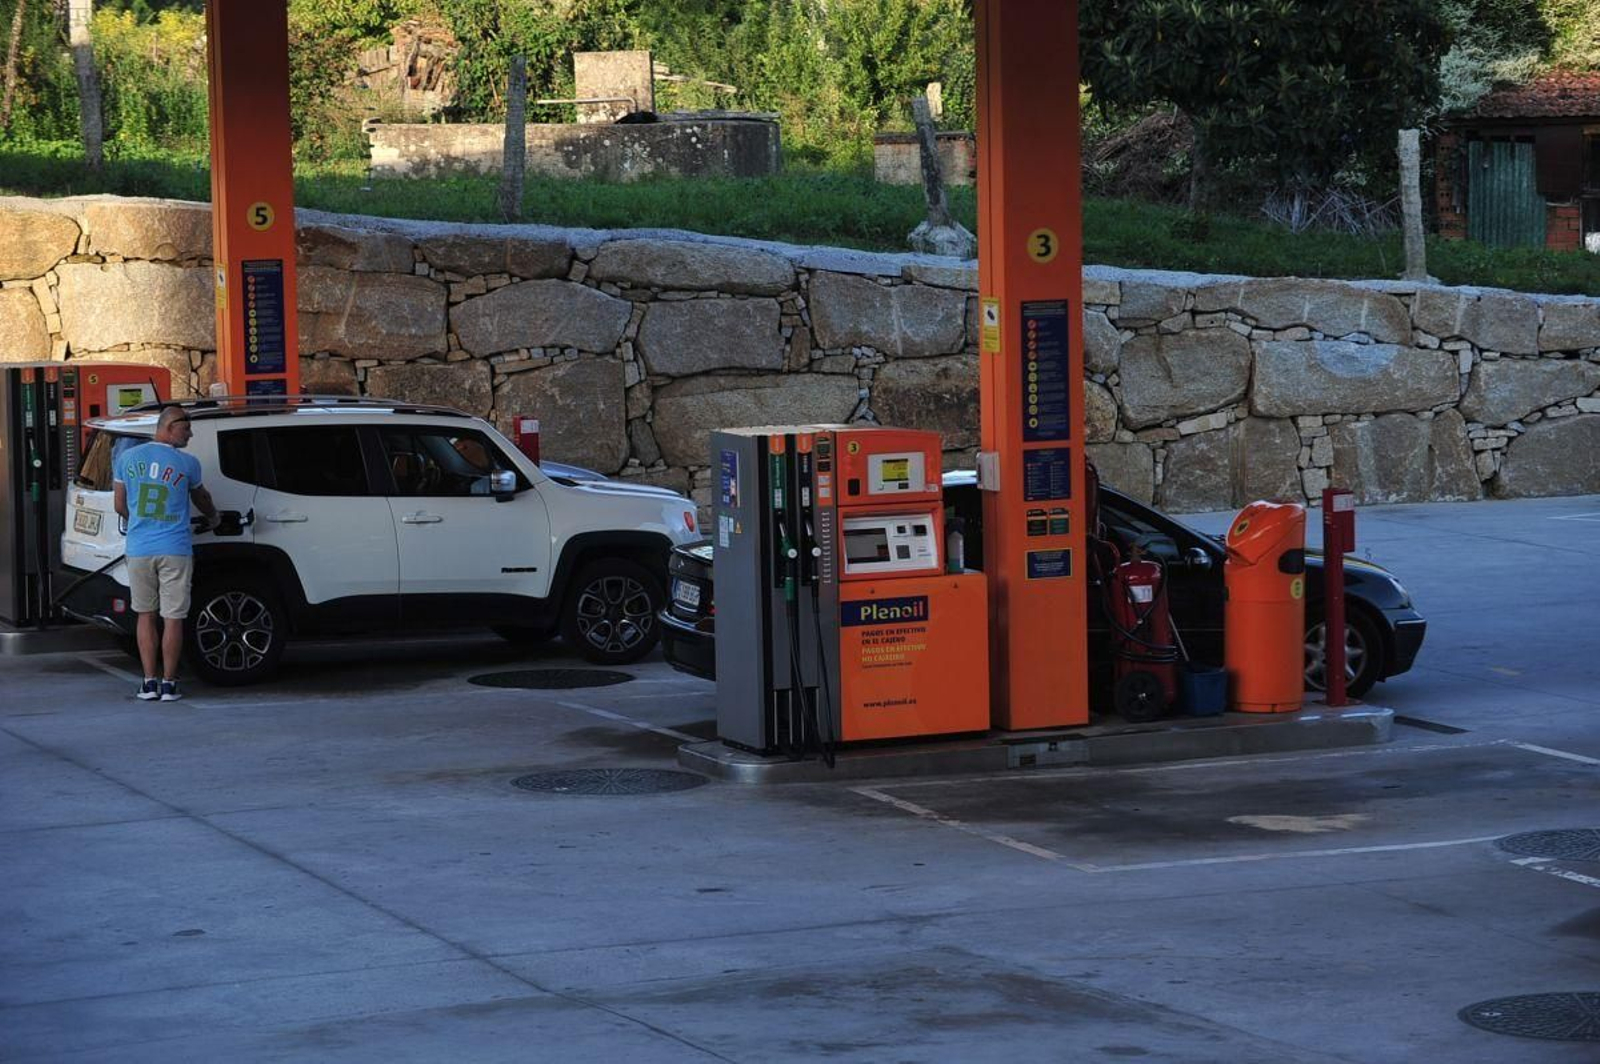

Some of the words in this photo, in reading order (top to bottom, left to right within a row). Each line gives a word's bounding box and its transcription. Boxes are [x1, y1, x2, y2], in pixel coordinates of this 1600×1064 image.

[255, 206, 268, 226] 5
[1036, 233, 1051, 257] 3
[127, 460, 185, 487] SPORT
[137, 482, 168, 518] B
[860, 601, 924, 620] Plenoil
